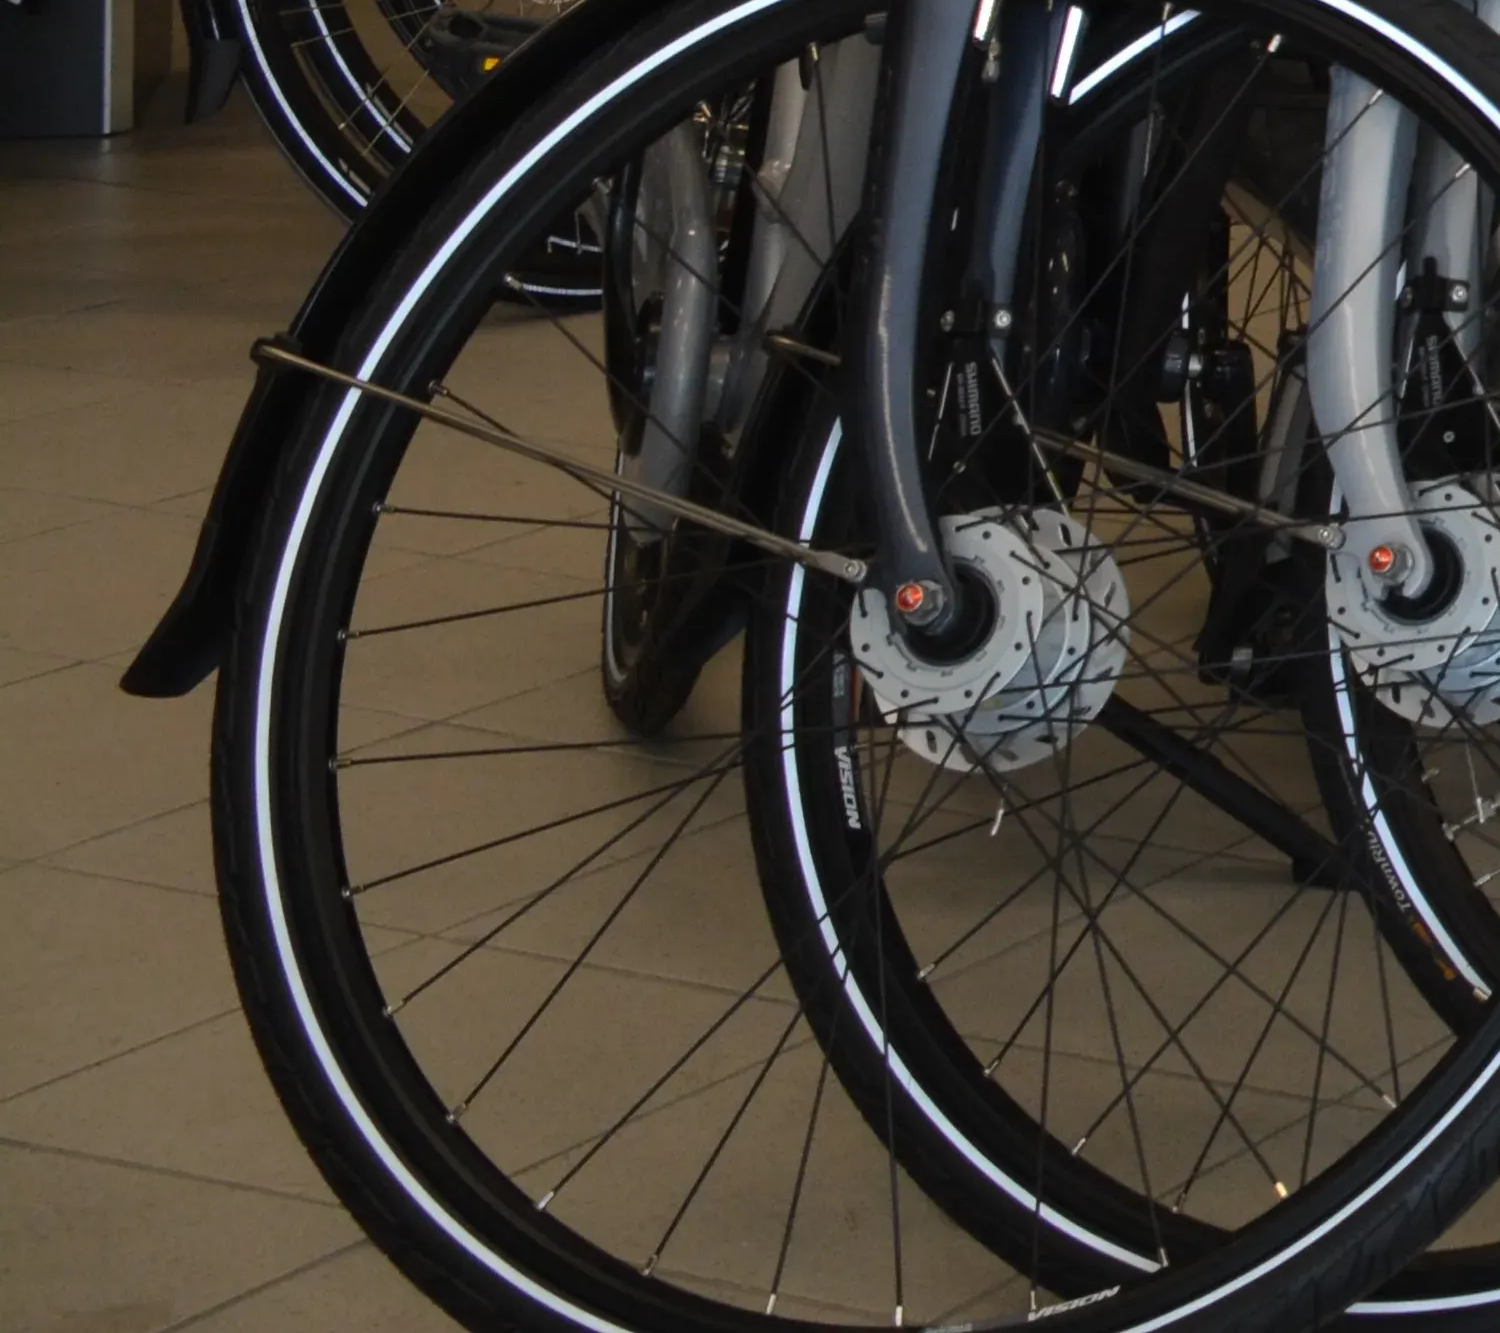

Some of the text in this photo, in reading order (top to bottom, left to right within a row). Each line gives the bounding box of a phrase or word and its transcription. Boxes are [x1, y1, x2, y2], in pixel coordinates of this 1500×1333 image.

[965, 361, 982, 437] SHIMANO
[836, 745, 862, 831] VISION
[1027, 1283, 1121, 1323] VISION
